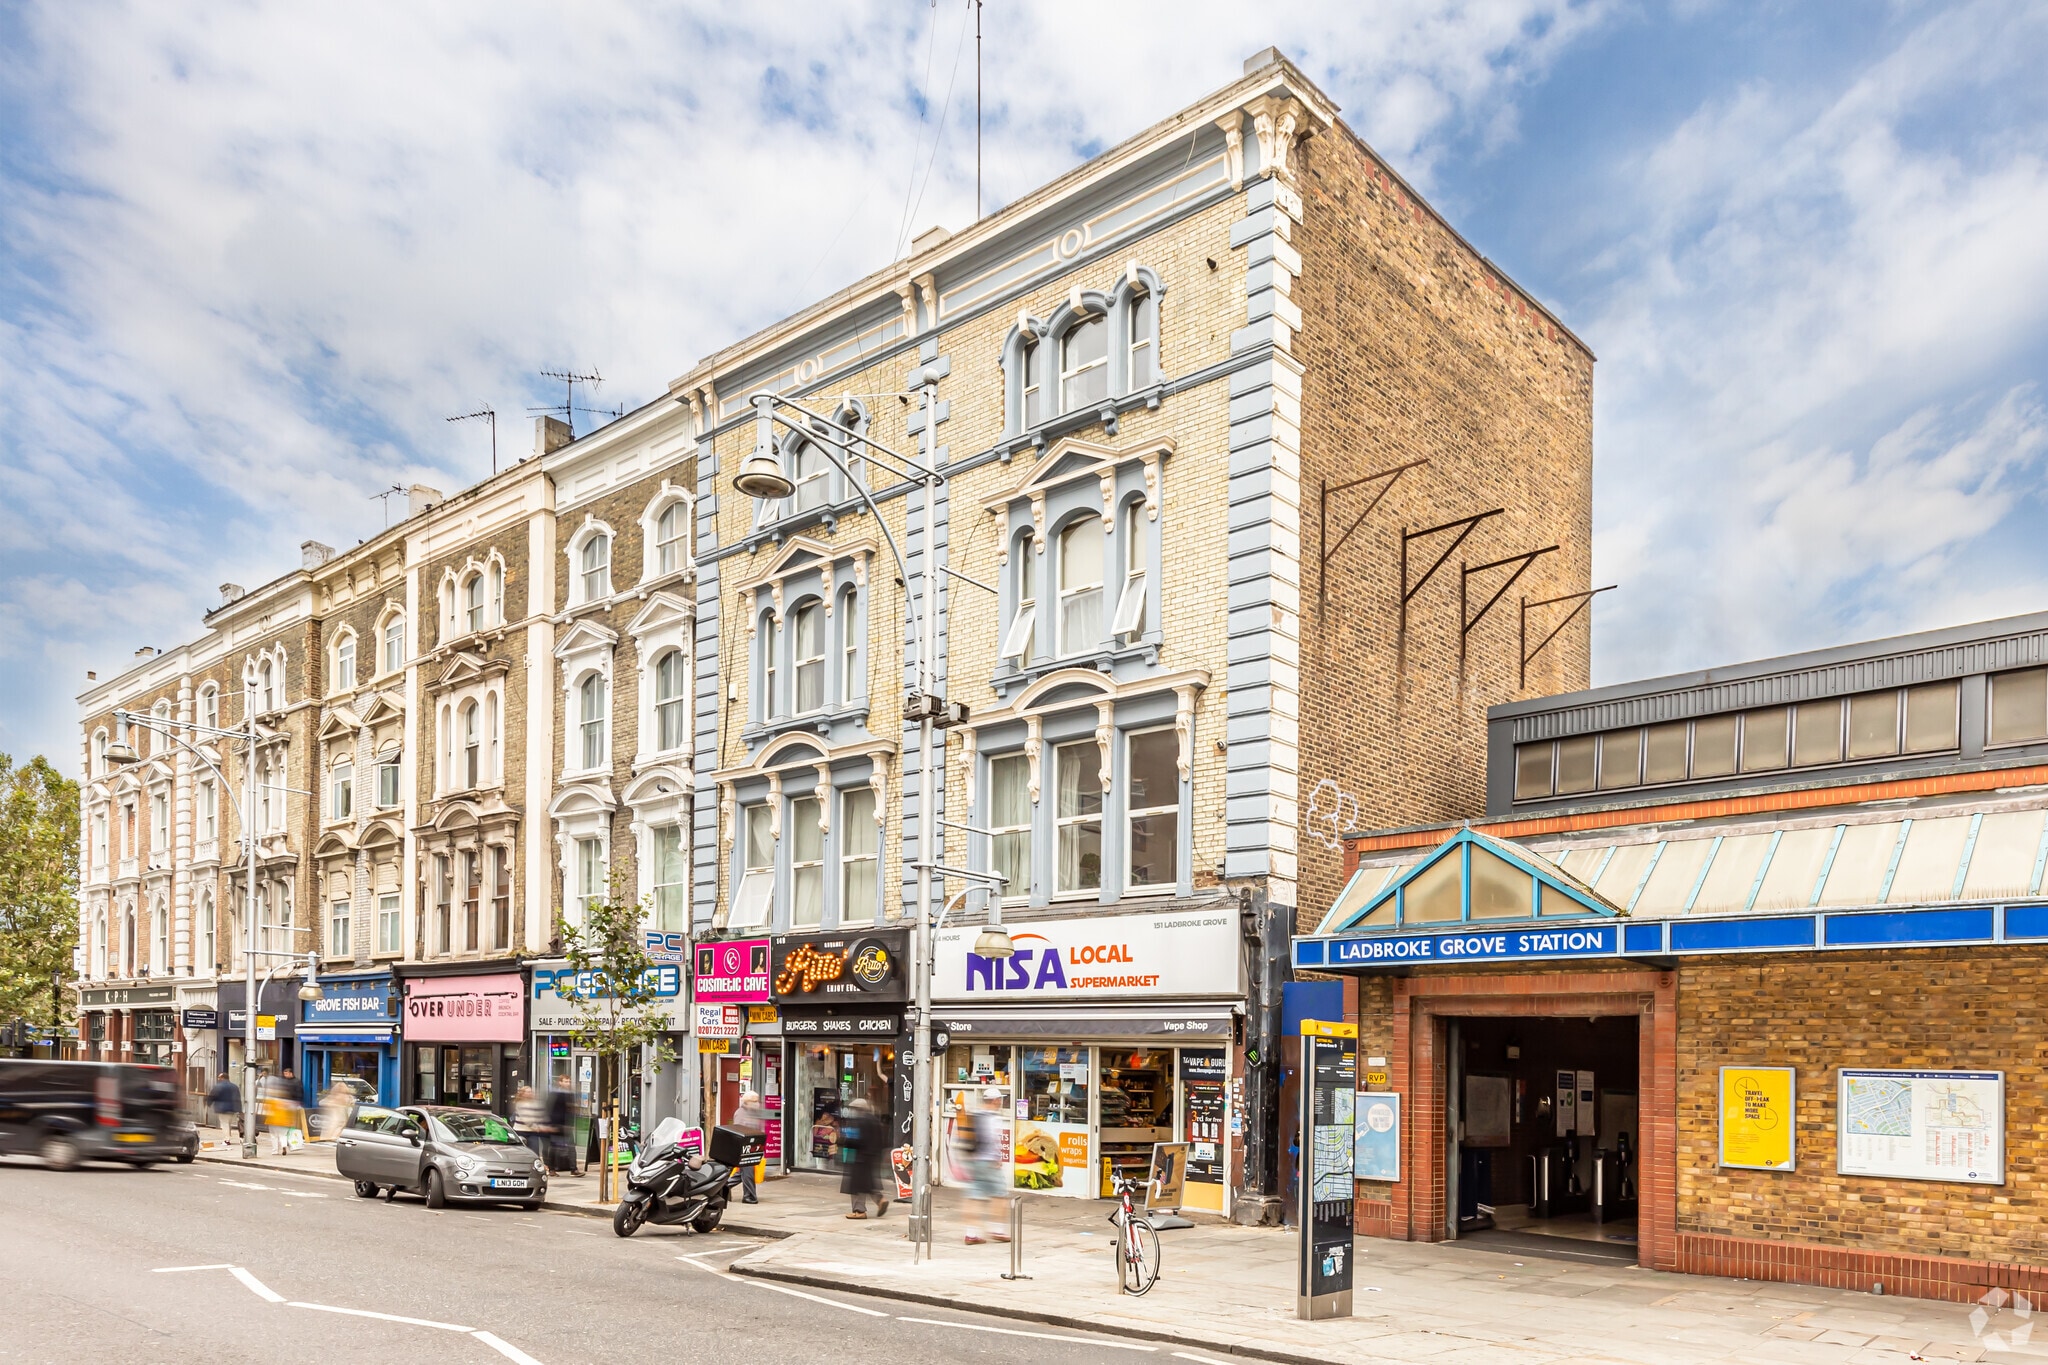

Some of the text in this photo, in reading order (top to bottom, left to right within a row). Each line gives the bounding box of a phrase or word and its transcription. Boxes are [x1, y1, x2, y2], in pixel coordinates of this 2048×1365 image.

[1165, 920, 1201, 928] LADBROKE
[1203, 918, 1227, 926] GROVE
[646, 932, 683, 952] PC
[1340, 932, 1602, 960] LADBROKE GROVE STATION
[966, 944, 1133, 991] NISA LOCAL
[743, 977, 768, 991] CAVE
[1070, 975, 1160, 989] SUPERMARKET
[315, 997, 379, 1011] GROVE FISH BAR
[411, 999, 492, 1017] OVER UNDER
[700, 1007, 721, 1017] Regal
[725, 1008, 738, 1016] MINI
[762, 1011, 774, 1021] CABS
[539, 1017, 553, 1026] SALE
[702, 1017, 719, 1025] Cars
[785, 1019, 892, 1031] BURGERS SHAKES CHICKEN
[951, 1021, 1208, 1032] Store Vape Shop
[698, 1026, 738, 1034] 0207 221 2222
[699, 1039, 727, 1050] MINI CABS
[1189, 1057, 1204, 1067] VAPE
[1368, 1074, 1385, 1082] RVP
[1068, 1136, 1088, 1147] rolls
[1060, 1147, 1083, 1157] wraps
